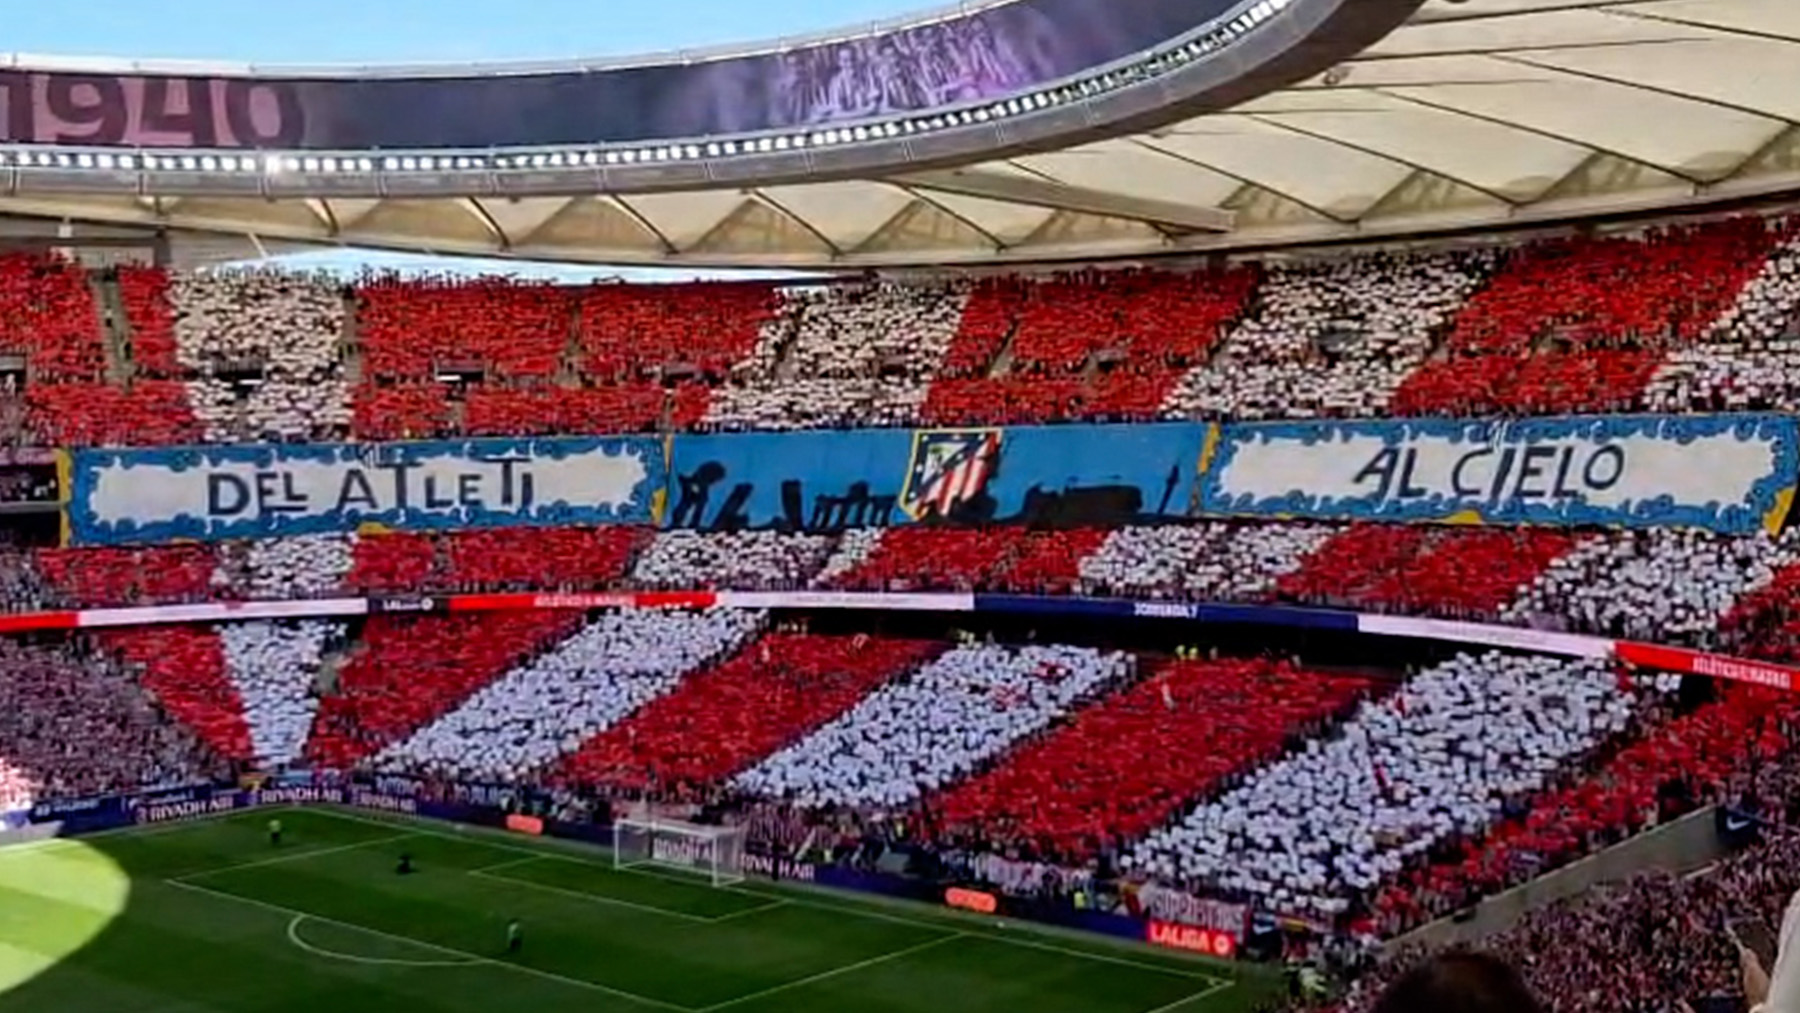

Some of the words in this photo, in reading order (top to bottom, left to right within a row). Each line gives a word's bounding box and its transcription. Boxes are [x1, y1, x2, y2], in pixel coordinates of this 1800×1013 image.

[0, 72, 304, 146] 1940
[207, 472, 309, 517] DEL
[335, 457, 533, 511] ATLETI
[1354, 446, 1425, 497] AL
[1450, 443, 1625, 499] CIELO
[150, 801, 207, 821] RIYADH
[1150, 922, 1210, 952] LALIGA
